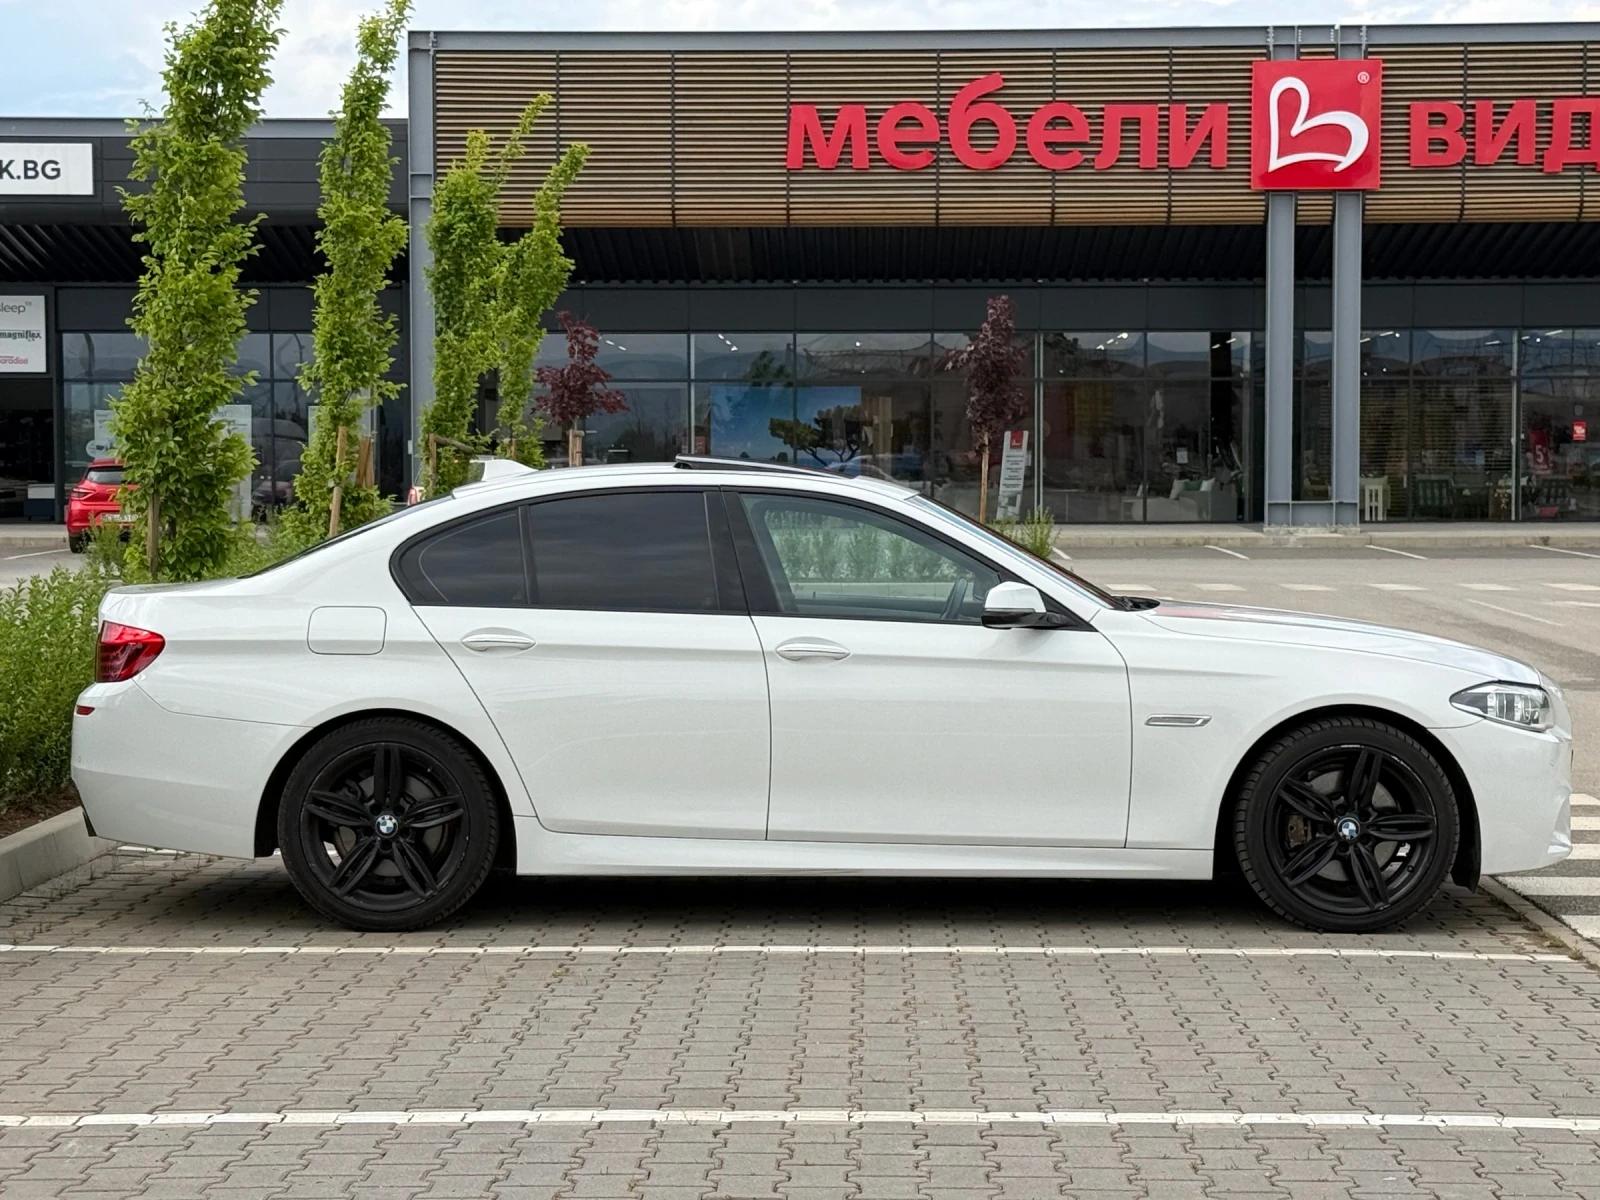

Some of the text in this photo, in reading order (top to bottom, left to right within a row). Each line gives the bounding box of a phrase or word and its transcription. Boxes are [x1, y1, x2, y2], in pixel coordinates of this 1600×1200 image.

[786, 72, 1228, 170] мебели
[0, 159, 61, 180] K.BG
[0, 302, 26, 315] leep
